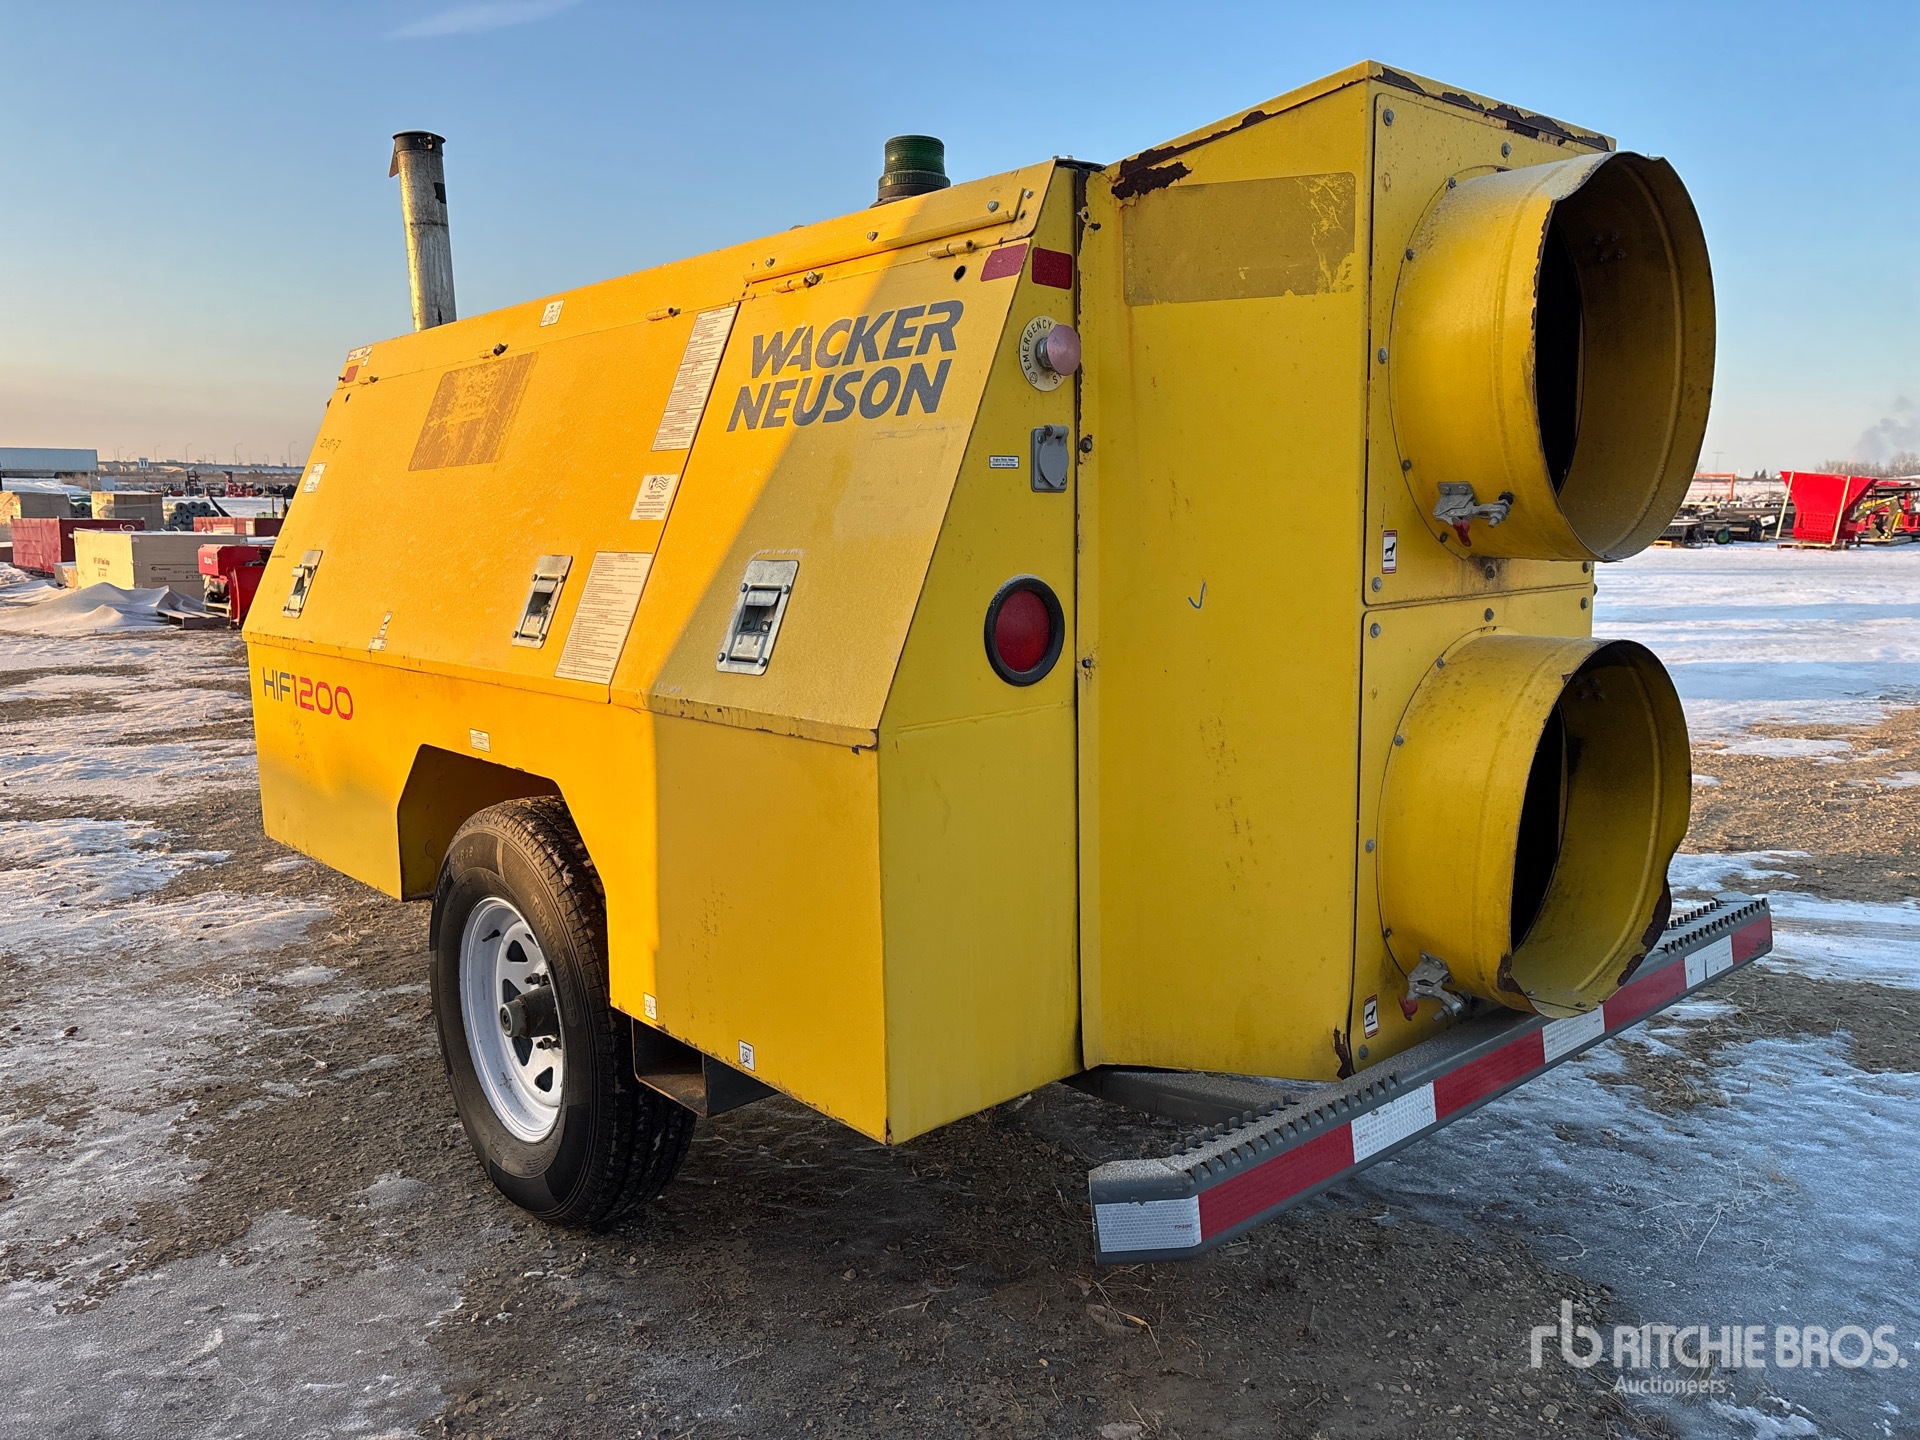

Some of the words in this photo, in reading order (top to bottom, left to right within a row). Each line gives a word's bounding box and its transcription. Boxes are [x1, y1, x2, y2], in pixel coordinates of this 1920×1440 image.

[751, 300, 964, 378] WACKER
[1022, 318, 1053, 371] EMERGENCY
[726, 359, 952, 432] NEUSON
[262, 666, 354, 721] HIF1200
[530, 892, 579, 1023] TRAILFINDER
